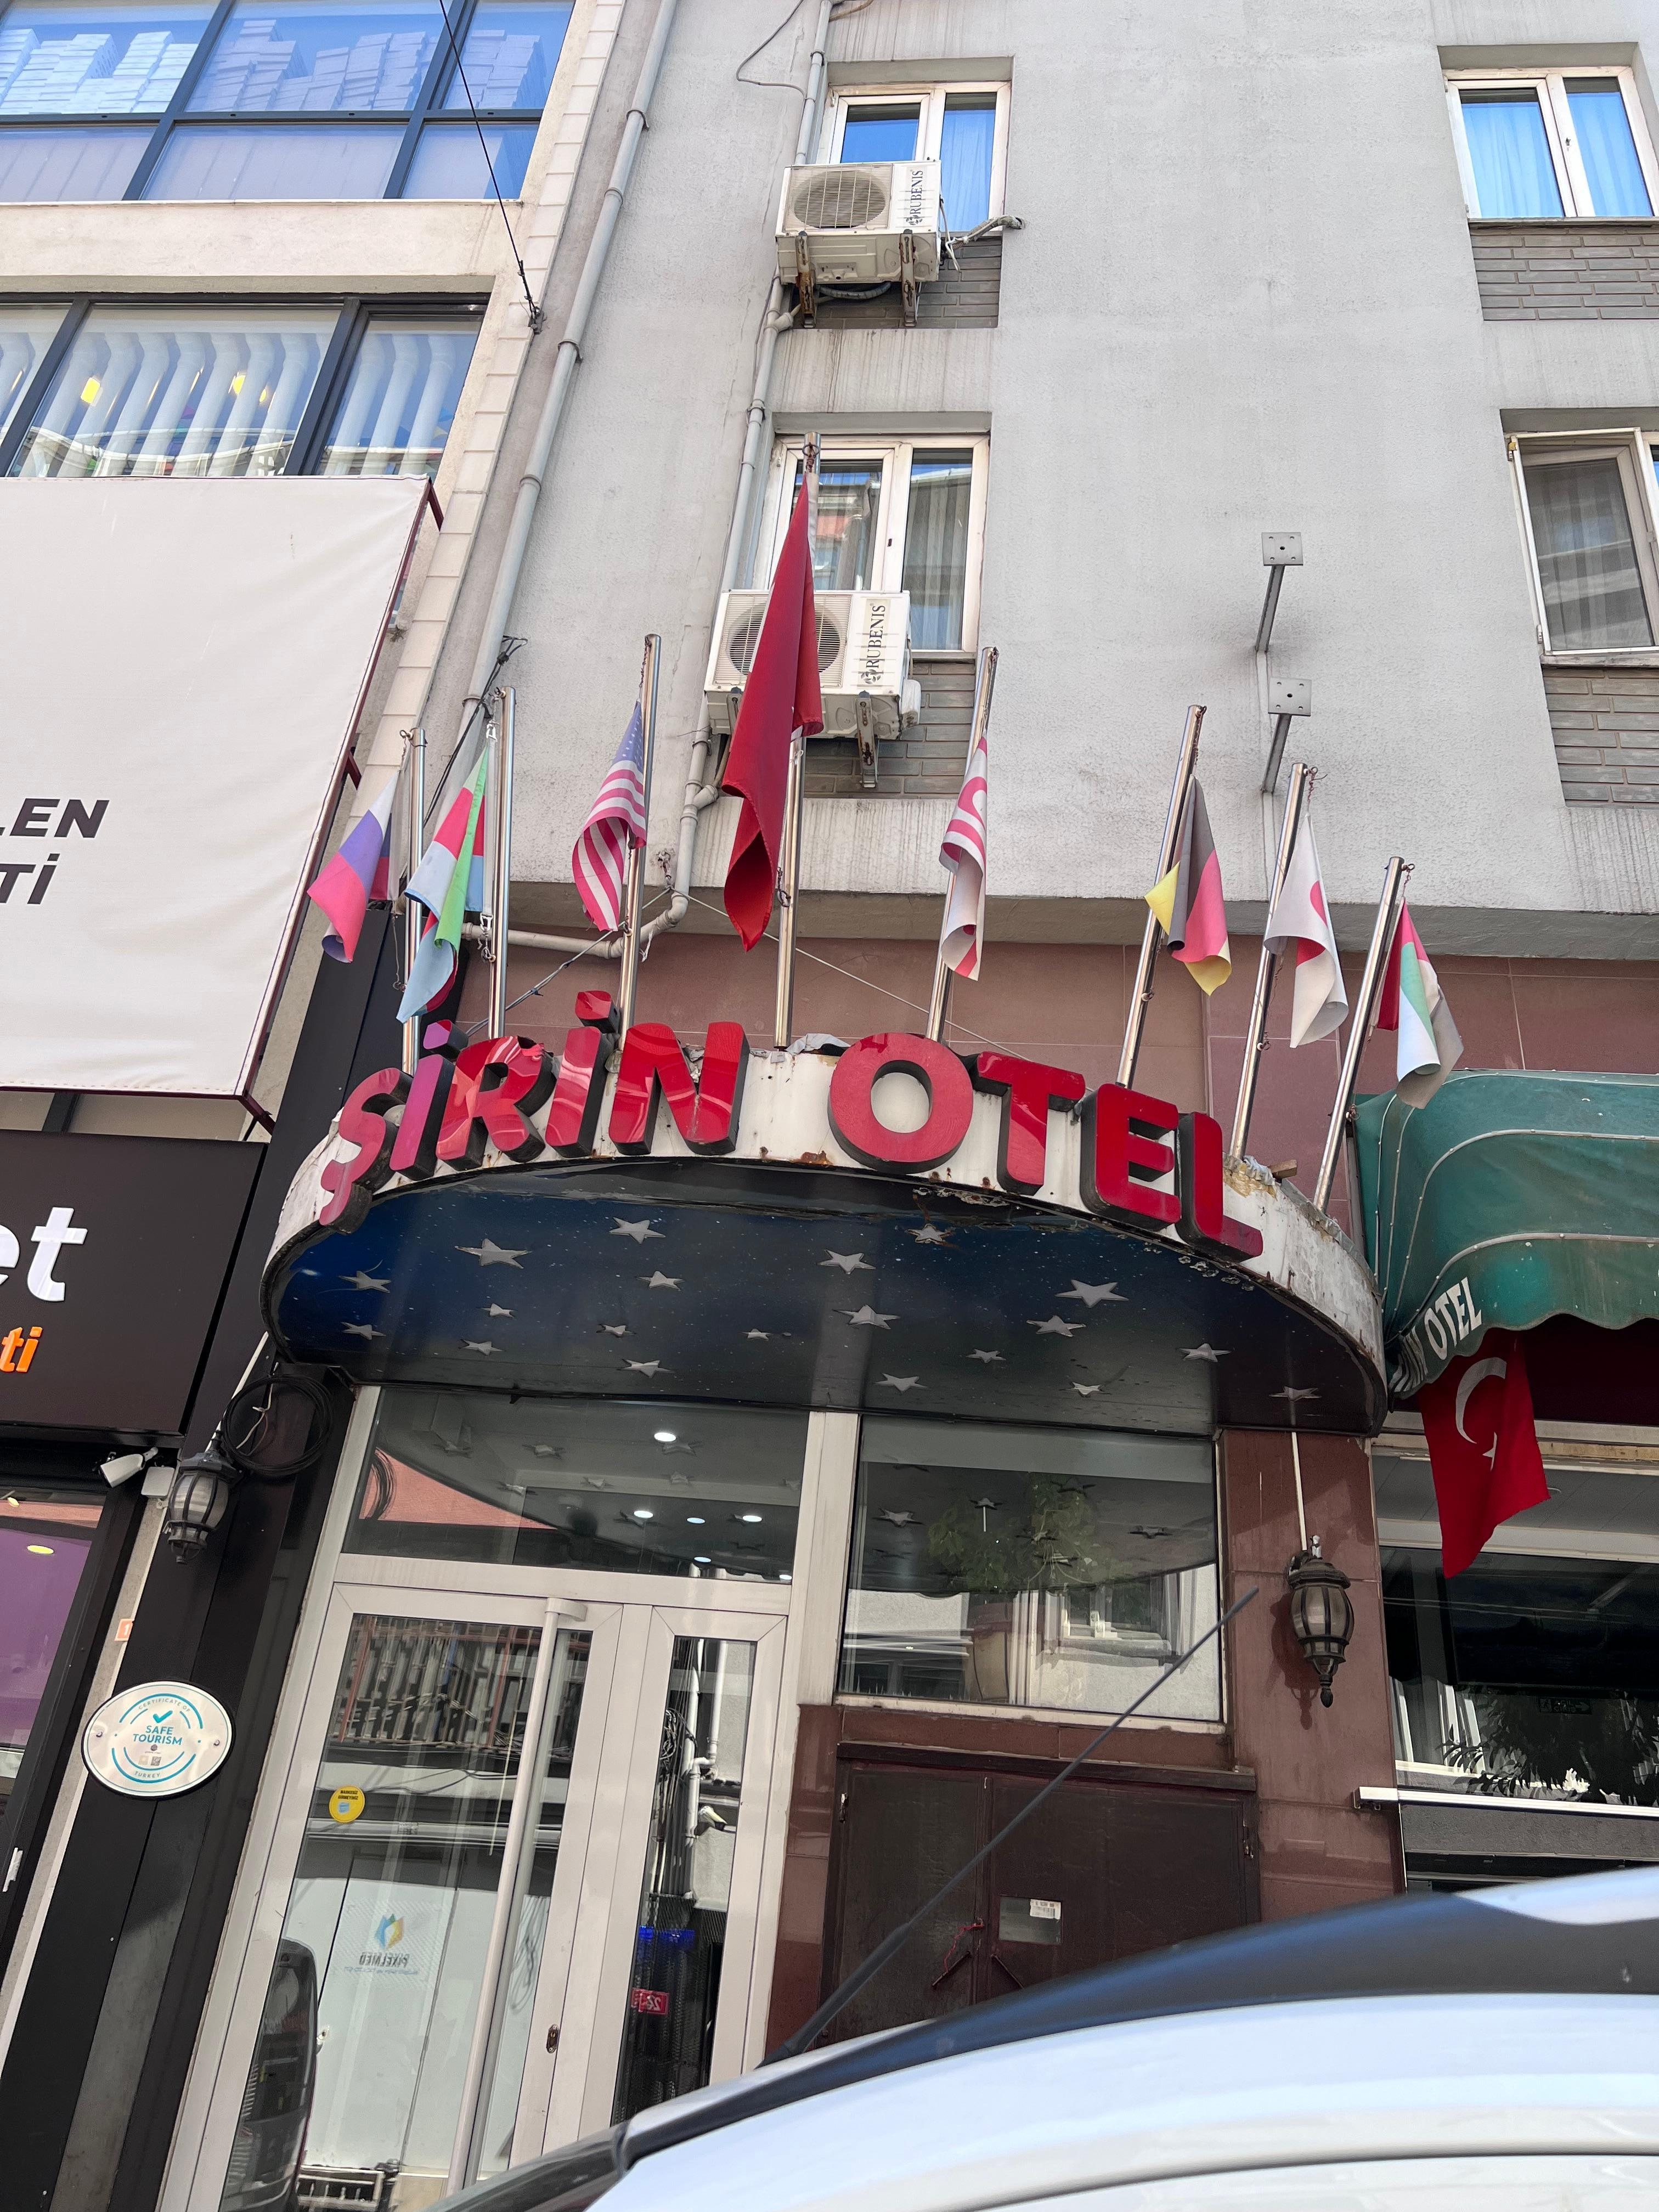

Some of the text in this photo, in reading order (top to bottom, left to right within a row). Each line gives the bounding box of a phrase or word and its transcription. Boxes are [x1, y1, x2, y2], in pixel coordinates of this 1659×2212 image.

[910, 171, 923, 214] RUBENIS
[866, 605, 885, 668] RUBENIS
[0, 798, 110, 838] EN
[319, 990, 1263, 1262] ŞİRİN OTEL
[1424, 1276, 1482, 1361] OTEL
[138, 1697, 191, 1713] CERTIFICATE OF
[133, 1733, 183, 1746] TOURISM
[145, 1725, 174, 1735] SAFE
[134, 1770, 161, 1779] TURKEY
